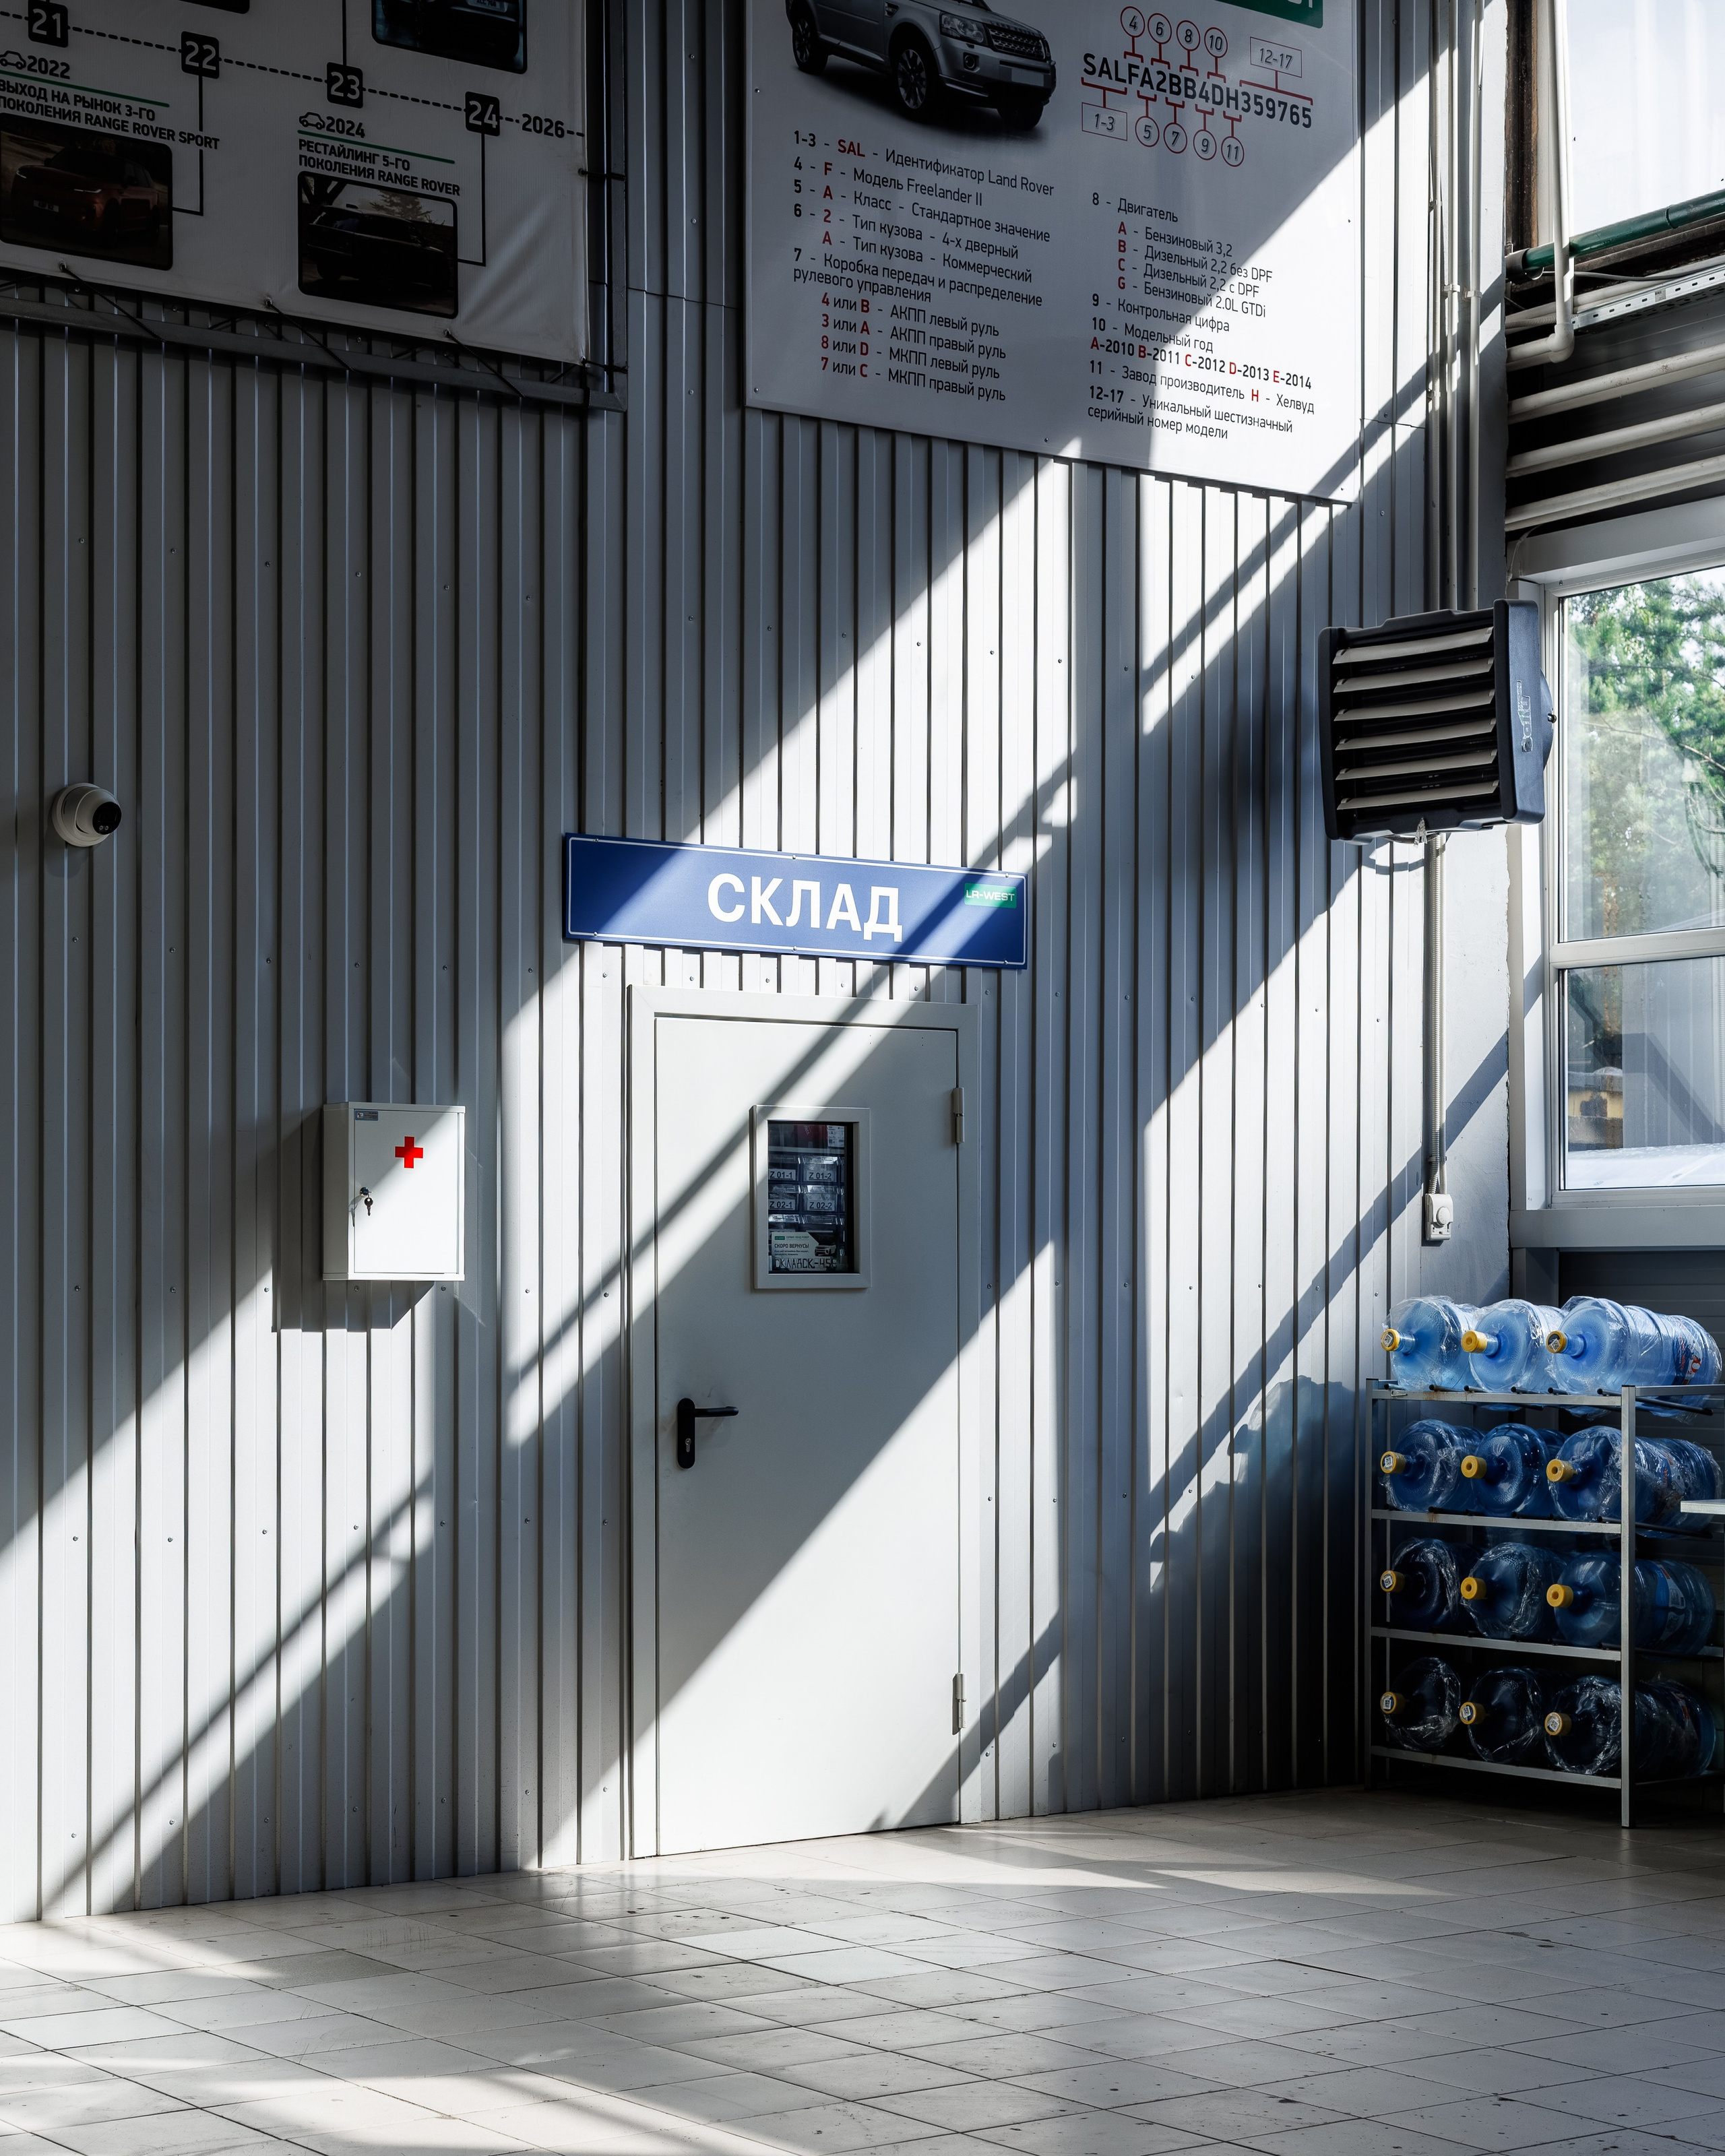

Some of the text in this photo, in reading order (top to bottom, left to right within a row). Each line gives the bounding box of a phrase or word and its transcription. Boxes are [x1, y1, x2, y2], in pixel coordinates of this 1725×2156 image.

[32, 8, 61, 38] 21
[1129, 15, 1137, 31] 4
[1155, 21, 1164, 36] 6
[1184, 28, 1193, 44] 8
[185, 40, 216, 71] 22
[1209, 34, 1223, 51] 10
[1259, 48, 1292, 69] 12-17
[27, 55, 70, 80] 2022
[330, 71, 360, 100] 23
[0, 79, 155, 122] ВЫХОД НА РЫНОК 3-ГО
[1083, 53, 1312, 129] SALFA2BB4DH359765
[0, 96, 220, 150] ПОКОЛЕНИЯ RANGE ROVER SPORT
[326, 116, 365, 138] 2024
[468, 100, 565, 138] 24 2026
[1094, 113, 1115, 131] 1-3
[1143, 125, 1152, 140] 5
[299, 138, 410, 171] РЕСТАЙЛИНГ 5-ГО
[1171, 131, 1179, 147] 7
[1201, 138, 1209, 154] 9
[1227, 144, 1239, 161] 11
[299, 155, 460, 196] ПОКОЛЕНИЯ RANGE ROVER
[794, 131, 1054, 195] 1-3 SAL Идентификатор Land Rover
[794, 156, 802, 170] 4
[824, 162, 833, 175] F
[854, 168, 904, 190] Модель
[907, 178, 972, 203] Freelander
[794, 179, 802, 193] 5
[854, 191, 891, 211] Класс
[912, 202, 991, 230] Стандартное
[995, 222, 1050, 242] значение
[1092, 192, 1178, 222] 8 Двигатель
[794, 203, 802, 218] 6
[823, 209, 832, 224] 2
[852, 214, 876, 232] Тип
[879, 223, 922, 241] кузова
[965, 239, 1019, 259] дверный
[1145, 226, 1213, 253] Бензиновый
[1216, 241, 1232, 257] 3,2
[794, 248, 1042, 307] 7 Коробка передач и распределение
[853, 236, 876, 253] Тип
[880, 245, 923, 262] кузова
[943, 253, 1032, 283] Коммерческий
[1145, 245, 1208, 270] Дизельный
[1211, 259, 1227, 275] 2,2
[1230, 263, 1248, 278] без
[1251, 267, 1272, 282] DPF
[794, 268, 931, 303] рулевого управления
[1118, 276, 1265, 317] G Бензиновый 2.0L GTDi
[1143, 263, 1207, 288] Дизельный
[1210, 276, 1226, 292] 2,2
[1229, 284, 1234, 293] с
[1238, 282, 1259, 297] DPF
[821, 292, 829, 306] 4
[834, 297, 856, 311] или
[890, 305, 926, 323] АКПП
[929, 315, 968, 331] левый
[971, 322, 999, 337] руль
[1092, 293, 1230, 333] 9 Контрольная цифра
[821, 313, 829, 327] 3
[834, 319, 856, 333] или
[890, 326, 925, 345] АКПП
[929, 336, 974, 354] правый
[978, 344, 1006, 359] руль
[1092, 317, 1213, 354] 10 Модельный год
[821, 335, 1000, 379] 8 или D МКПП левый руль
[1090, 337, 1311, 389] A-2010 B-2011 C-2012 D-2013 E-2014
[821, 356, 829, 371] 7
[833, 362, 856, 376] или
[888, 368, 926, 388] МКПП
[929, 378, 974, 396] правый
[978, 387, 1006, 402] руль
[1090, 360, 1102, 375] 11
[1122, 366, 1156, 386] Завод
[1160, 375, 1245, 400] производитель
[1276, 393, 1314, 415] Хелвуд
[1088, 406, 1228, 439] серийный номер модели
[1090, 385, 1292, 433] 12-17 Уникальный шестизначный
[708, 873, 902, 943] СКЛАД
[966, 889, 1015, 901] LR-WEST
